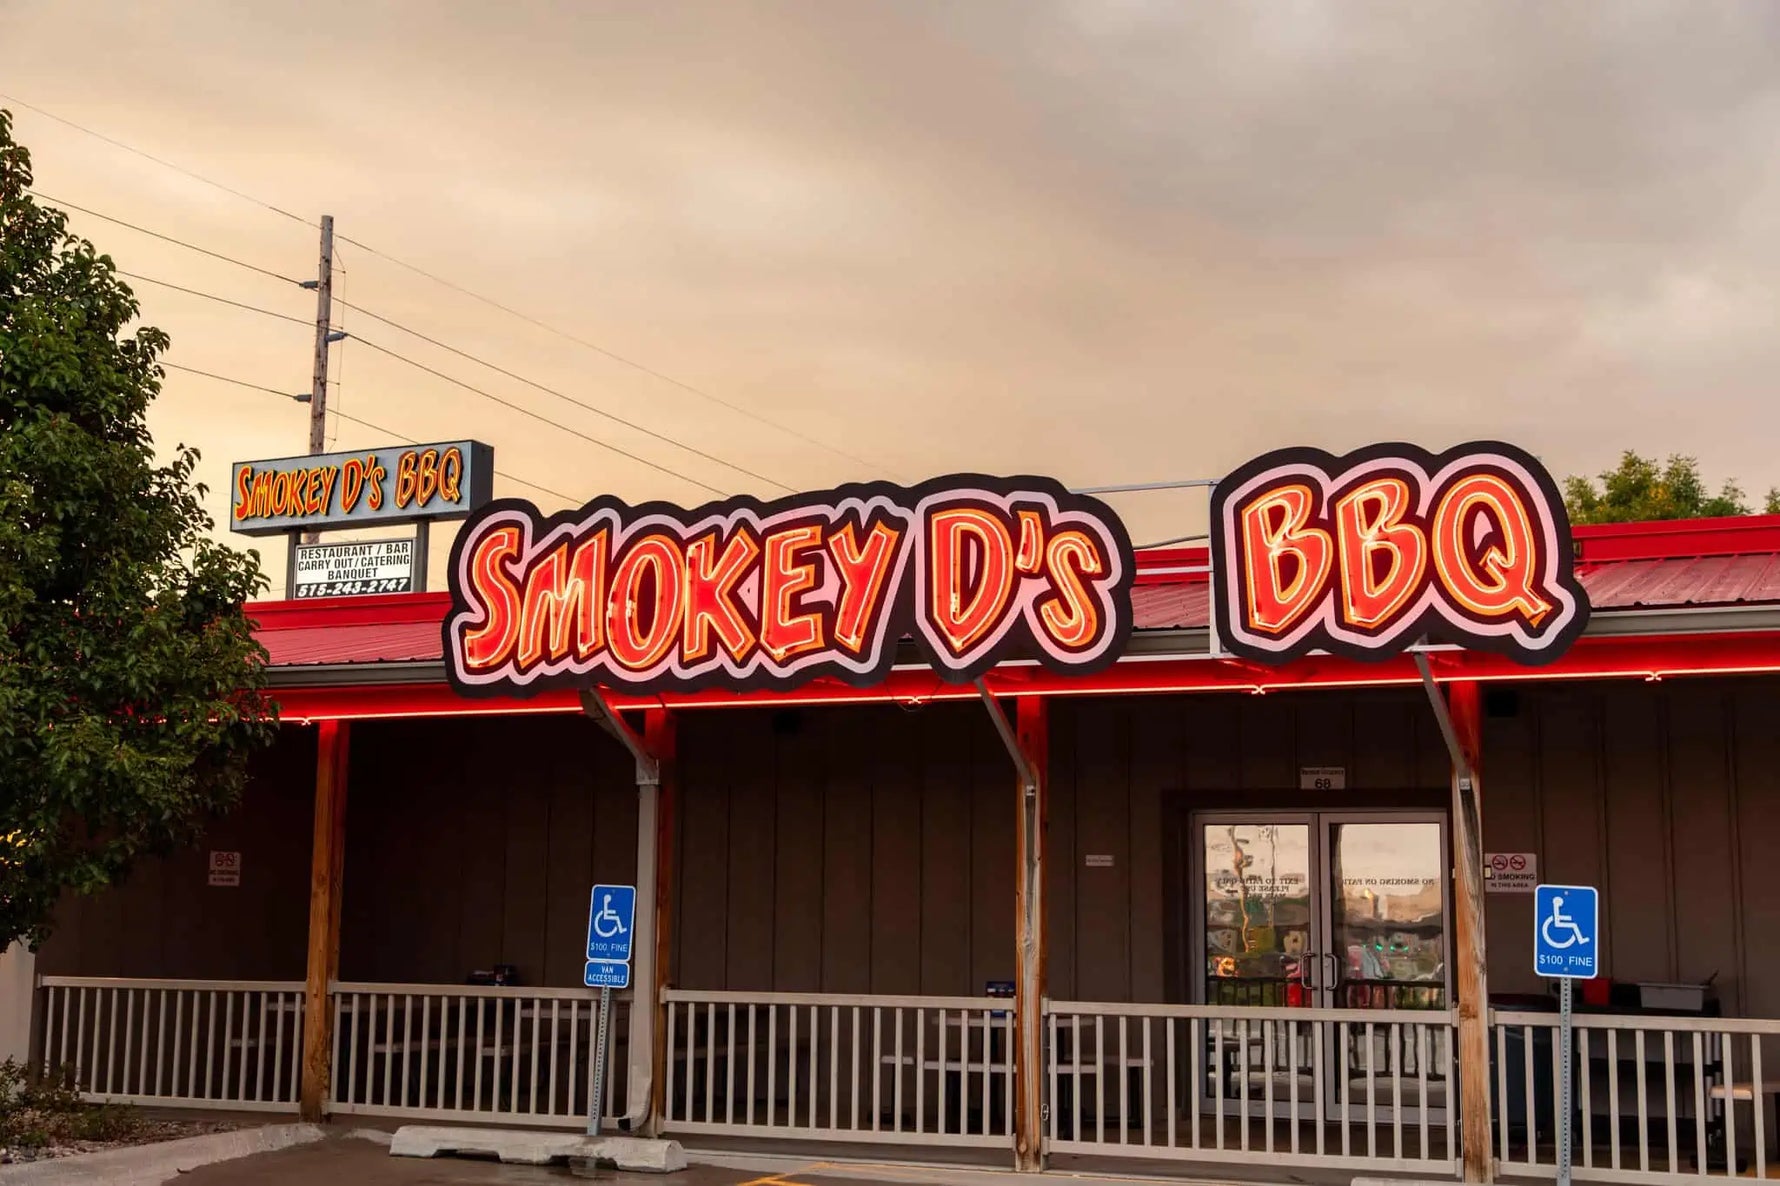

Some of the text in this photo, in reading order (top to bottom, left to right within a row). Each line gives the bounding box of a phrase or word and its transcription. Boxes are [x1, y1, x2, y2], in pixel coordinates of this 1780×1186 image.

[234, 465, 337, 521] SMOKEY
[395, 446, 464, 509] BBQ
[300, 545, 374, 560] RESTAURANT
[386, 543, 408, 554] BAR
[298, 559, 331, 571] CARRY
[328, 567, 378, 580] BANQUET
[465, 519, 900, 670] SMOKEY
[1241, 473, 1552, 633] BBQ
[298, 579, 408, 597] 515-243-2747
[590, 942, 628, 952] $100 FINE
[1539, 955, 1592, 967] $100 FINE
[601, 965, 614, 974] VAN
[588, 974, 626, 984] ACCESSIBLE
